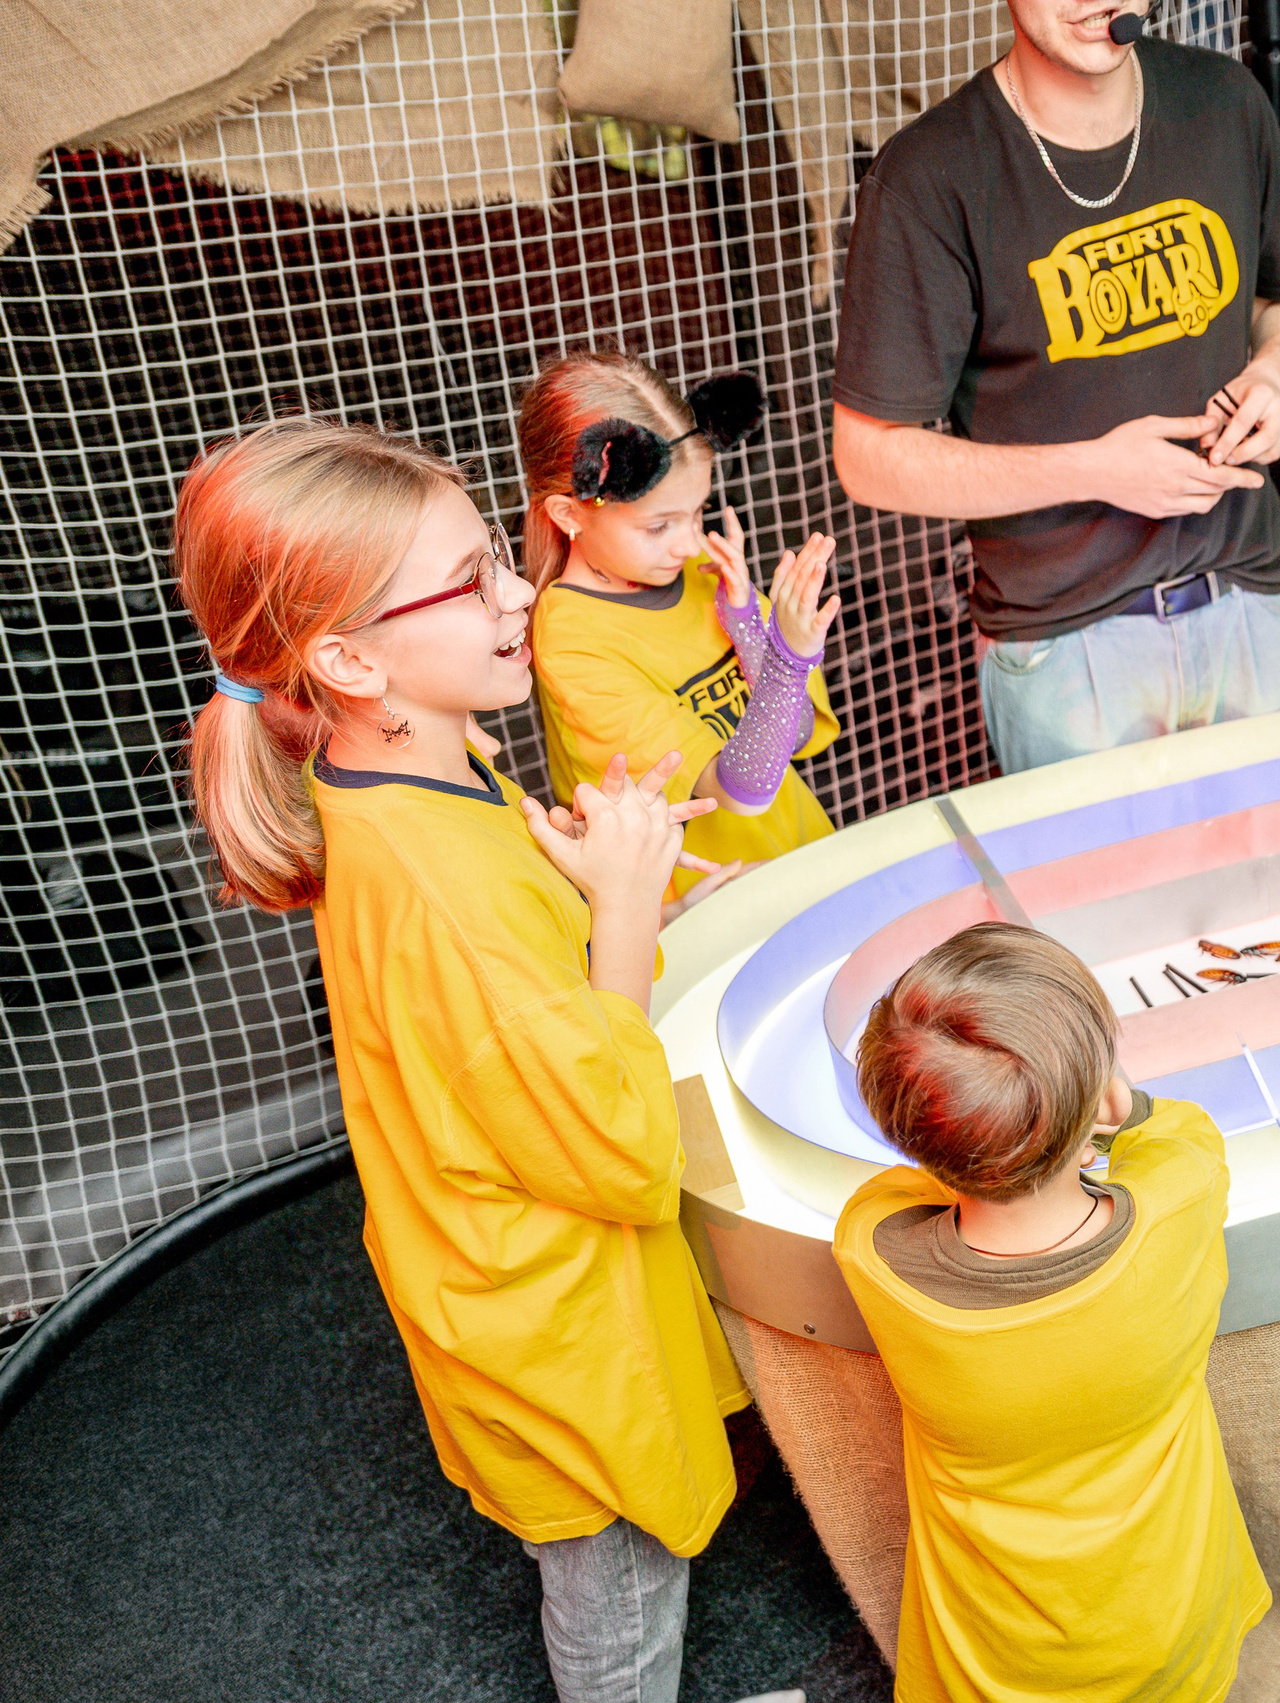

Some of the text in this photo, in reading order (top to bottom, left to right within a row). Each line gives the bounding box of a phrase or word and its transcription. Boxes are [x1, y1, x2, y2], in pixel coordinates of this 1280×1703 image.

[1083, 218, 1175, 272] FORT
[1027, 198, 1240, 364] BOYARD
[690, 664, 746, 713] FOR
